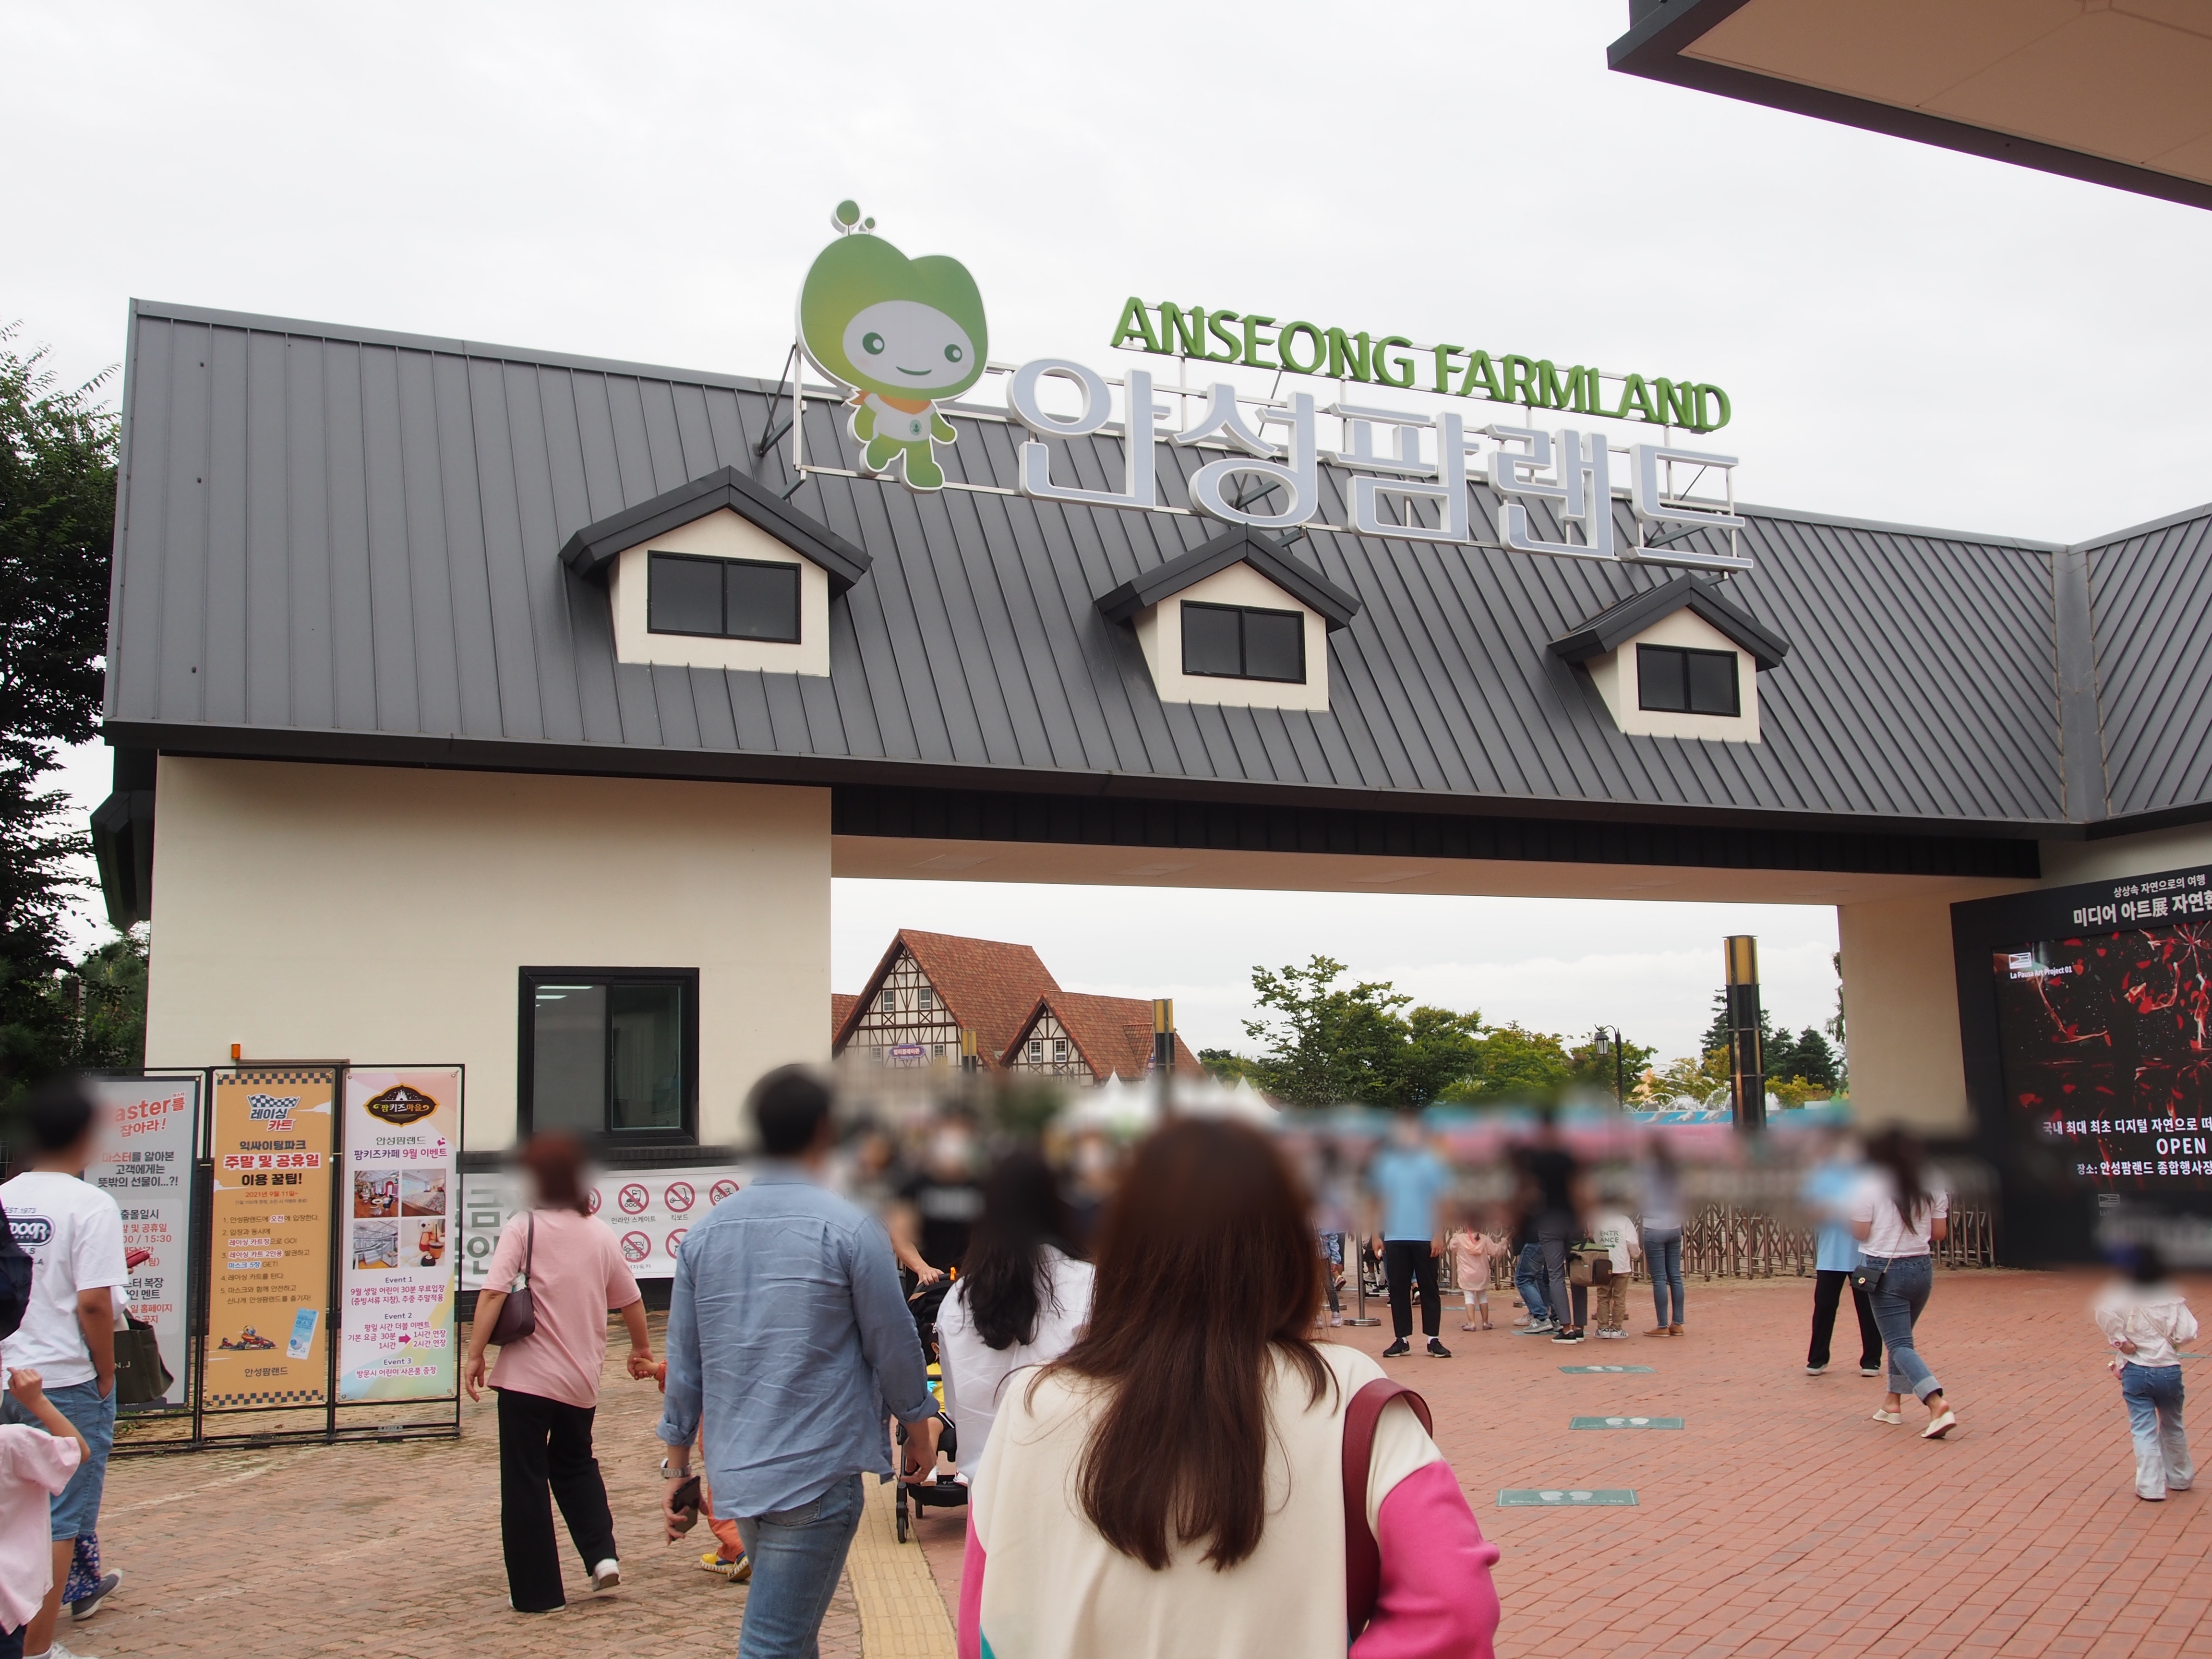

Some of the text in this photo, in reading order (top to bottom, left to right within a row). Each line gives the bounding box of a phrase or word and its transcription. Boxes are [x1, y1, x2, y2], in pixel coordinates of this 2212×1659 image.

[1110, 297, 1731, 431] ANSEONG FARMLAND
[1006, 358, 1754, 572] 안성팜랜드
[2114, 874, 2205, 898] 상상속 자연으로의 여행
[2073, 903, 2117, 927] 미디어
[2121, 897, 2168, 921] 아트展
[2044, 967, 2064, 976] Project
[115, 1097, 185, 1122] aster를
[251, 1108, 288, 1119] 레이싱
[120, 1118, 167, 1138] 잡아라!
[268, 1119, 293, 1130] 카트
[2043, 1121, 2063, 1135] 국내
[2066, 1120, 2087, 1134] 최대
[2090, 1119, 2112, 1134] 최초
[2115, 1118, 2148, 1133] 디지털
[2152, 1117, 2198, 1132] 자연으로
[240, 1140, 306, 1151] 익싸이팅파크
[376, 1136, 426, 1145] 안성팜랜드
[2156, 1137, 2207, 1155] OPEN
[102, 1151, 174, 1162] 마스터를 알아본
[403, 1149, 417, 1159] 9월
[421, 1148, 447, 1159] 이벤트
[225, 1154, 319, 1168] 주말 및 공휴일
[116, 1164, 165, 1174] 고객에게는
[2077, 1163, 2098, 1175] 장소:
[2100, 1161, 2154, 1176] 안성팜랜드
[98, 1176, 178, 1188] 뜻밖의 선물이...?!
[241, 1173, 302, 1186] 이용 꿀팁!
[121, 1209, 159, 1220] 출몰일시
[131, 1224, 139, 1233] 및
[142, 1223, 167, 1233] 공휴일
[144, 1277, 164, 1288] 복장
[141, 1289, 160, 1300] 멘트
[364, 1287, 377, 1296] 생일
[351, 1297, 380, 1306] (증빙서류
[402, 1295, 415, 1303] 주중
[417, 1294, 444, 1302] 주말적용
[141, 1303, 172, 1313] 홈페이지
[364, 1324, 377, 1333] 평일
[395, 1322, 408, 1330] 더블
[410, 1321, 430, 1329] 이벤트
[348, 1334, 361, 1342] 기본
[363, 1333, 377, 1341] 요금
[433, 1330, 446, 1338] 연장
[433, 1339, 446, 1347] 연장
[244, 1367, 288, 1377] 안성팜랜드
[357, 1370, 377, 1378] 방문시
[379, 1368, 399, 1376] 어린이
[423, 1366, 436, 1375] 증정
